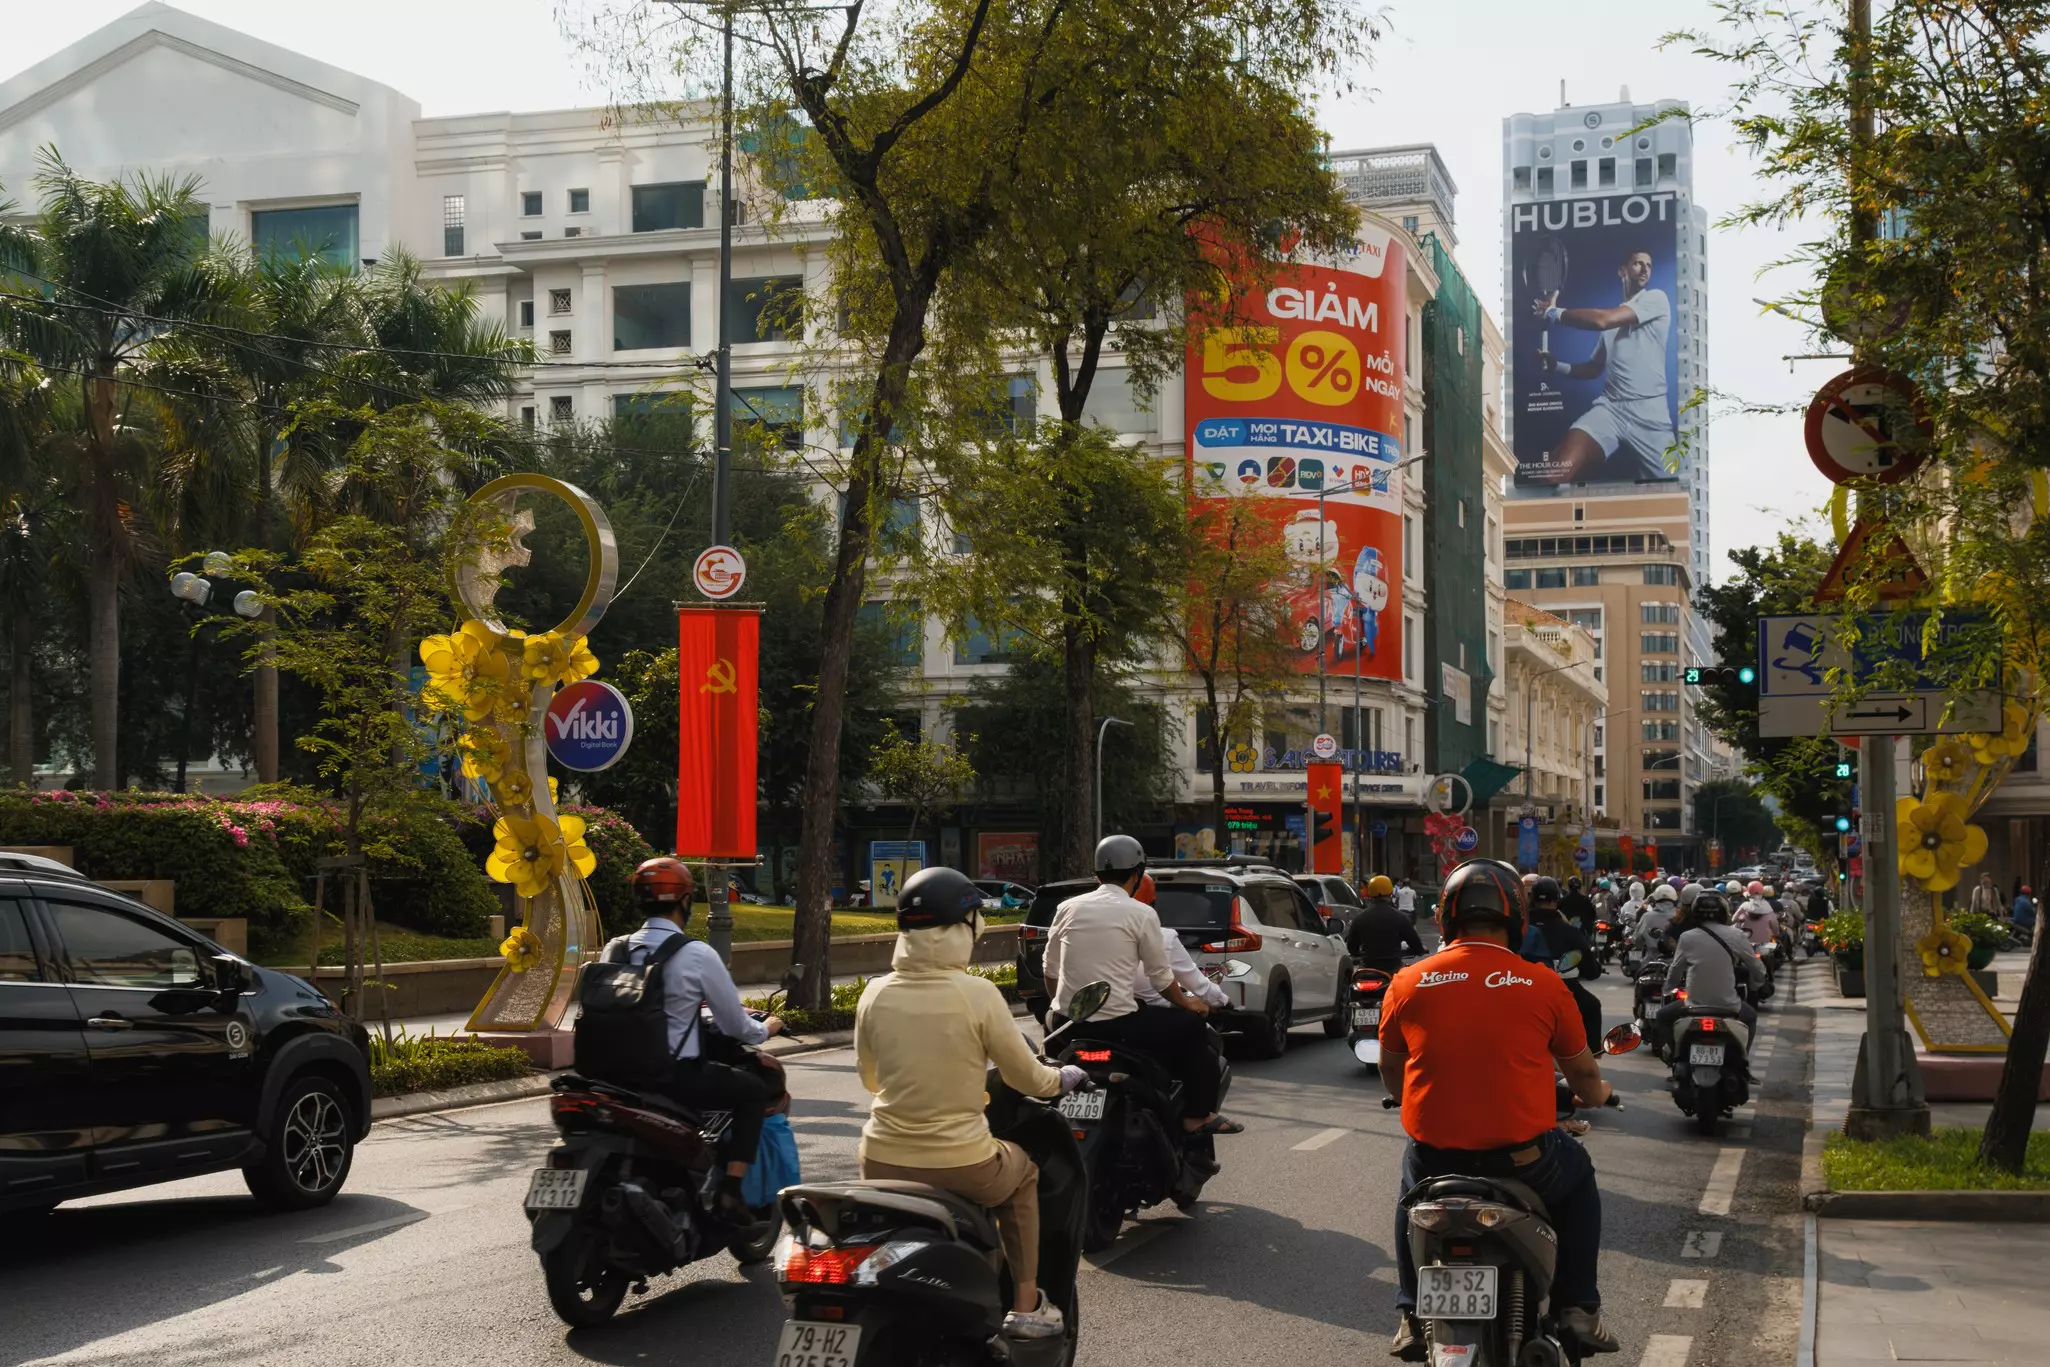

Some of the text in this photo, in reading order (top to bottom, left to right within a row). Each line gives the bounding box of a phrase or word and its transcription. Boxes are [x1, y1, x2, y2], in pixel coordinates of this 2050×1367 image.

[1514, 193, 1674, 233] HUBLOT
[1267, 281, 1378, 333] GIẢM
[1365, 376, 1401, 401] NGÀY
[1280, 424, 1379, 455] TAXI-BIKE
[1686, 669, 1699, 682] 29
[548, 697, 618, 740] Vikki
[580, 741, 600, 749] Digital
[1416, 970, 1533, 989] Merino Celano
[1061, 1103, 1099, 1118] 202.09
[1430, 1270, 1486, 1292] 59-S2
[1422, 1294, 1491, 1315] 328.83
[791, 1326, 847, 1354] 79-H2
